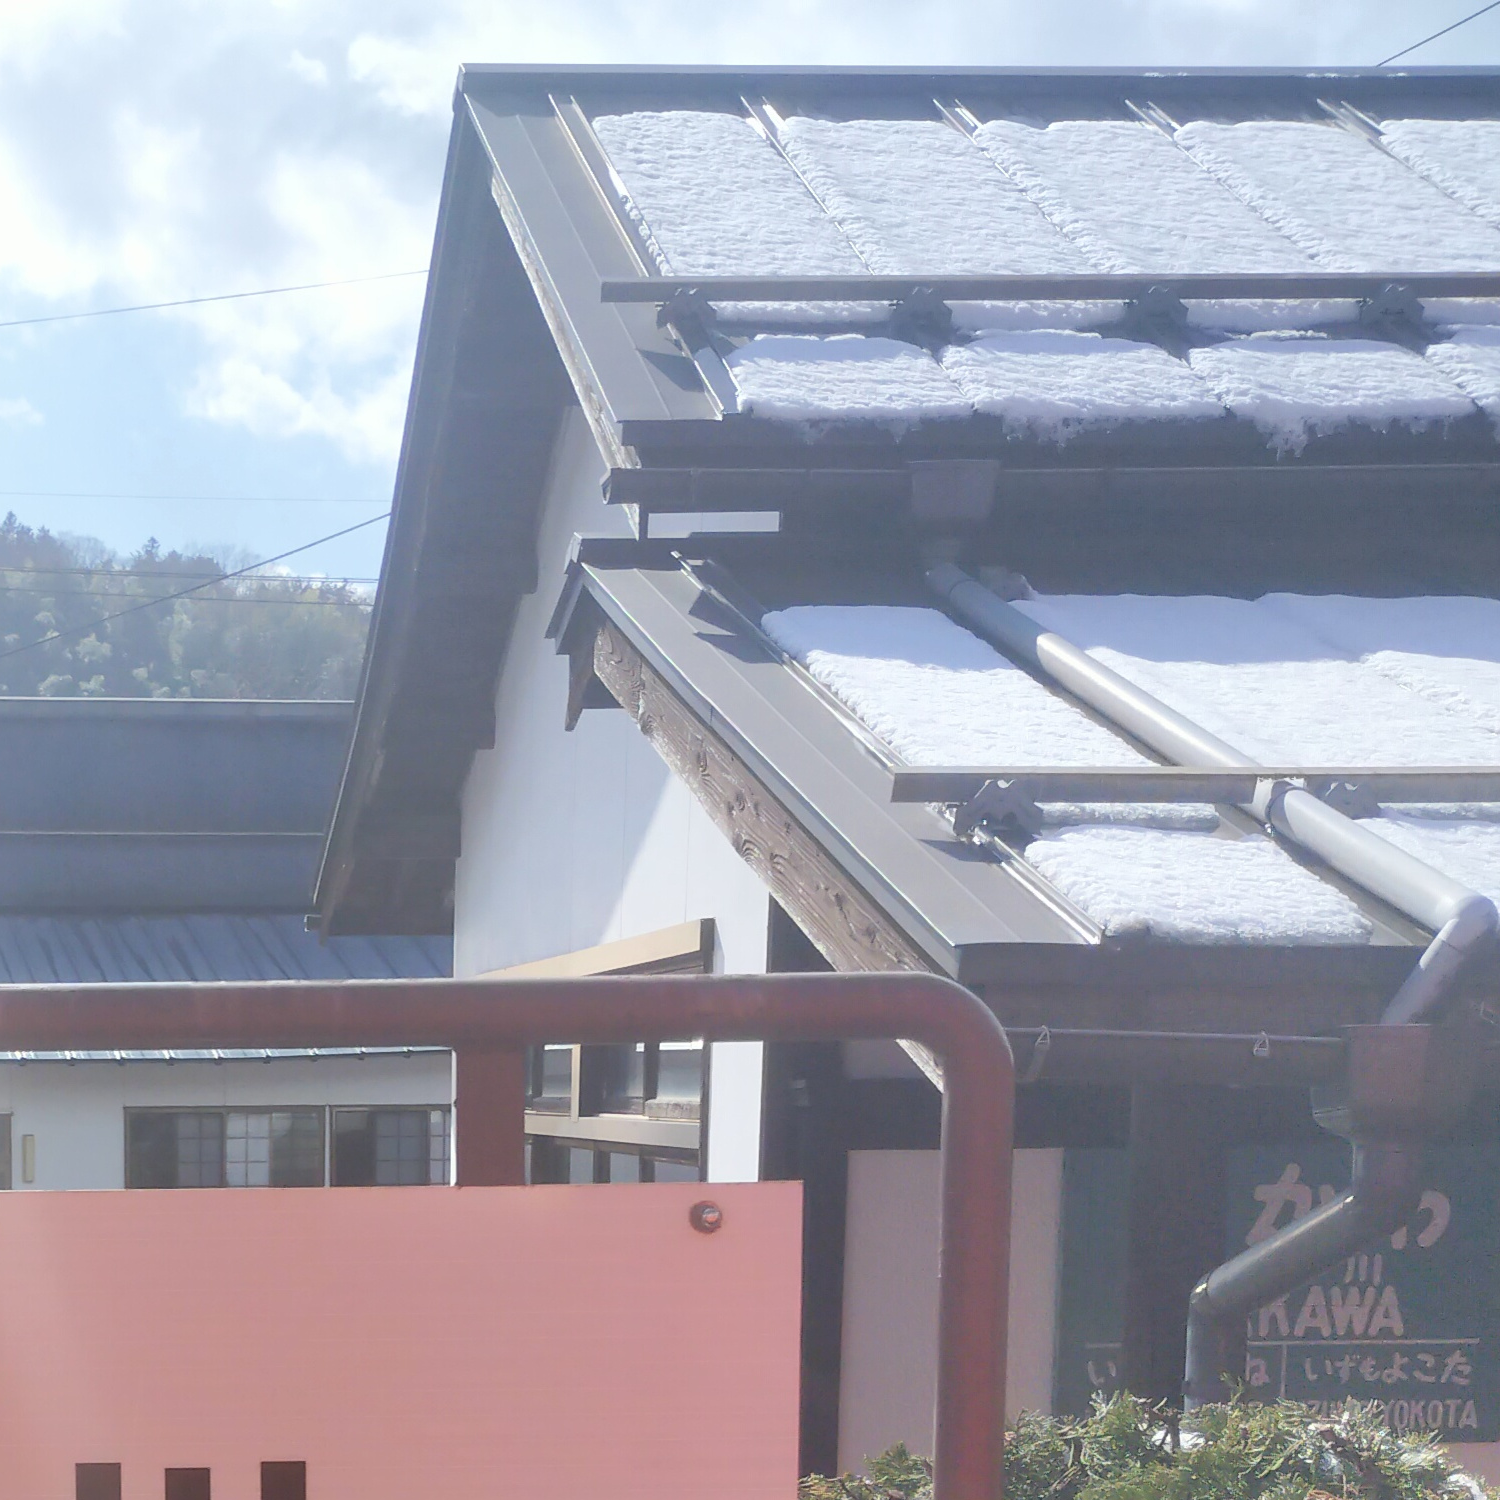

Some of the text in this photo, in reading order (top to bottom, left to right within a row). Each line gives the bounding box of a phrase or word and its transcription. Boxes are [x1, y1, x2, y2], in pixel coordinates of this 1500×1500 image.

[1247, 1285, 1405, 1338] KAWA
[1304, 1350, 1473, 1386] いずもよこた
